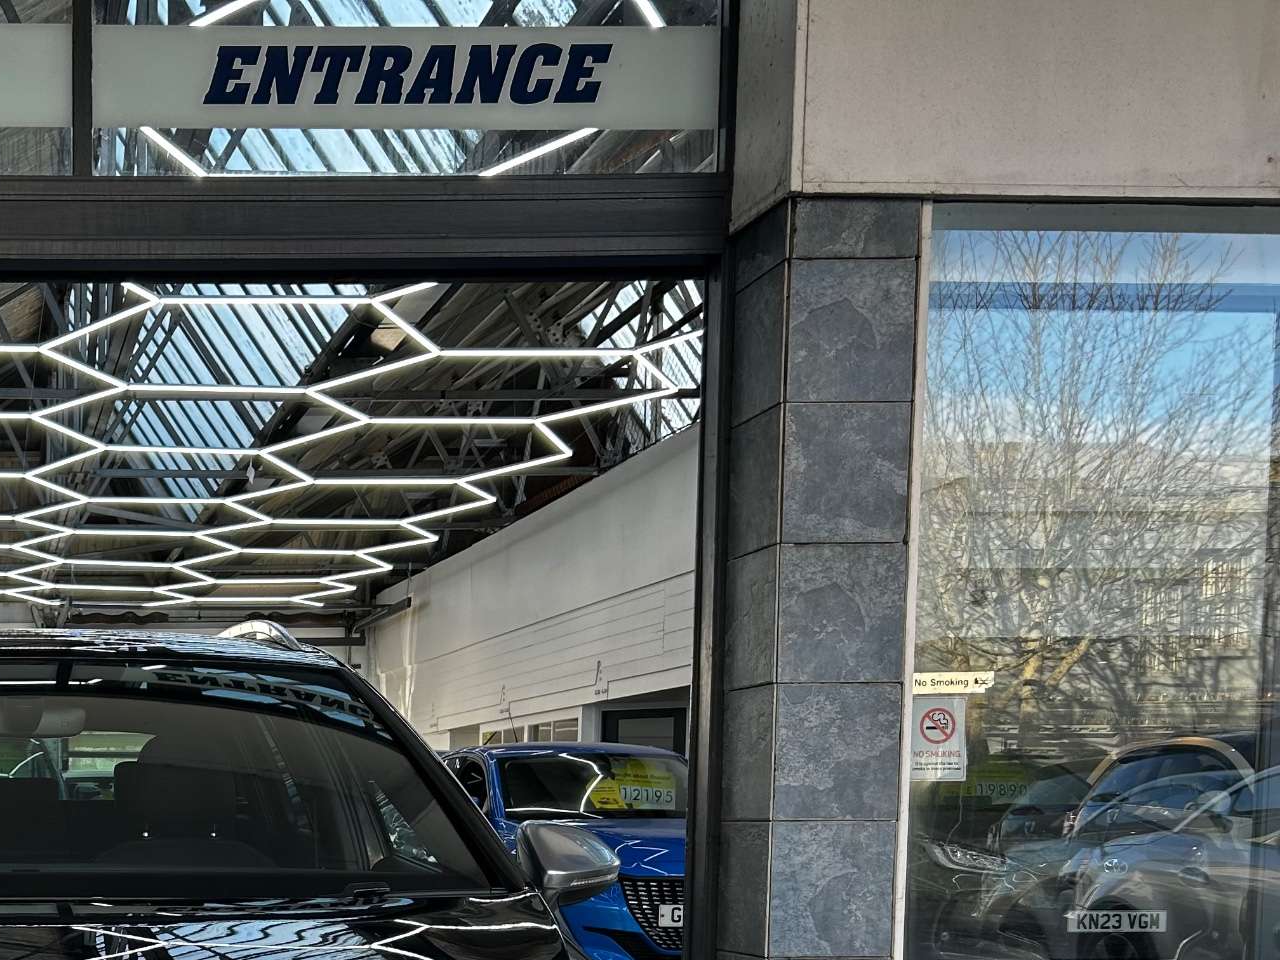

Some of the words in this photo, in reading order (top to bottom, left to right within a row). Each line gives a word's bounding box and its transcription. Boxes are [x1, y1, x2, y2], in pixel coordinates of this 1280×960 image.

[201, 41, 615, 107] ENTRANCE
[914, 679, 928, 687] No
[930, 678, 969, 689] Smoking
[913, 750, 924, 758] NO
[622, 787, 673, 803] 12195
[1076, 913, 1122, 930] KN23
[1127, 913, 1160, 930] VGM
